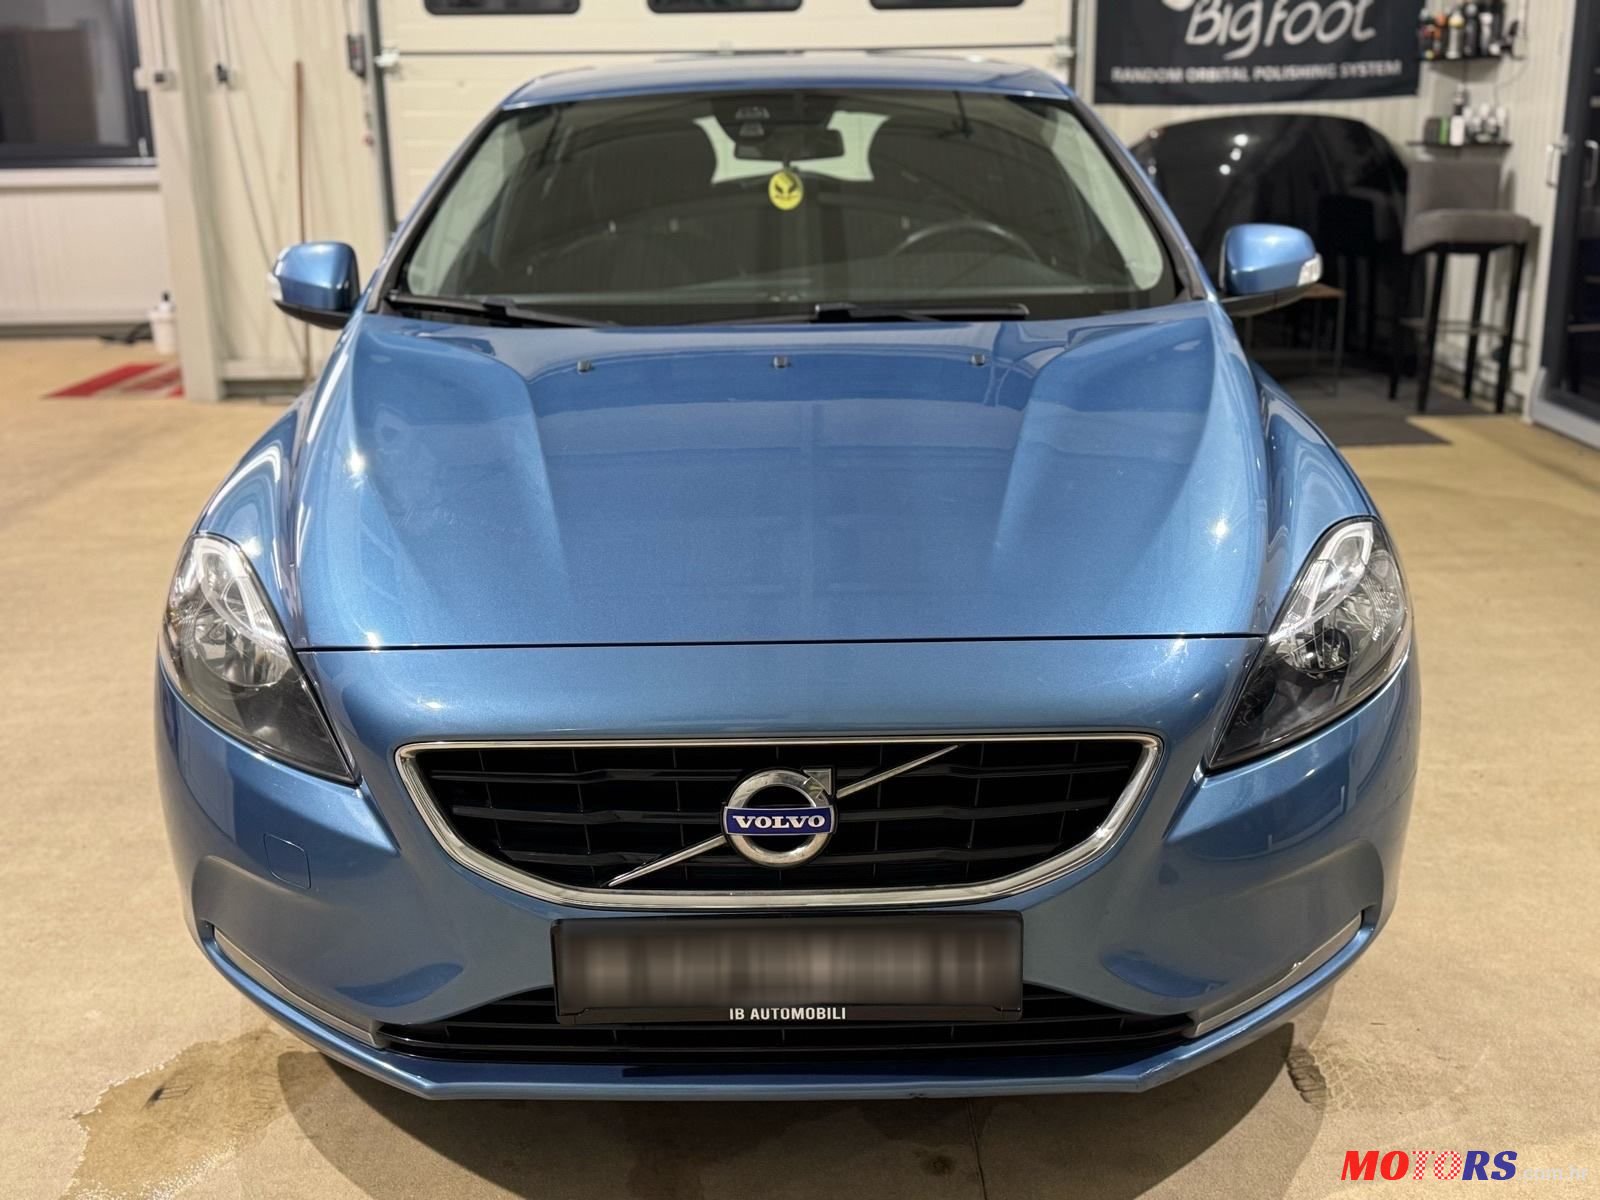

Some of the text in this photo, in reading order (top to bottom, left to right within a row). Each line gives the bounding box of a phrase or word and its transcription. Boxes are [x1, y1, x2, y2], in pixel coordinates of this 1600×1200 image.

[1111, 59, 1402, 83] RANDOM ORBITAL POLISHING SYSTEM
[732, 815, 826, 829] VOLVO
[729, 1007, 846, 1020] IB AUTOMOBILI
